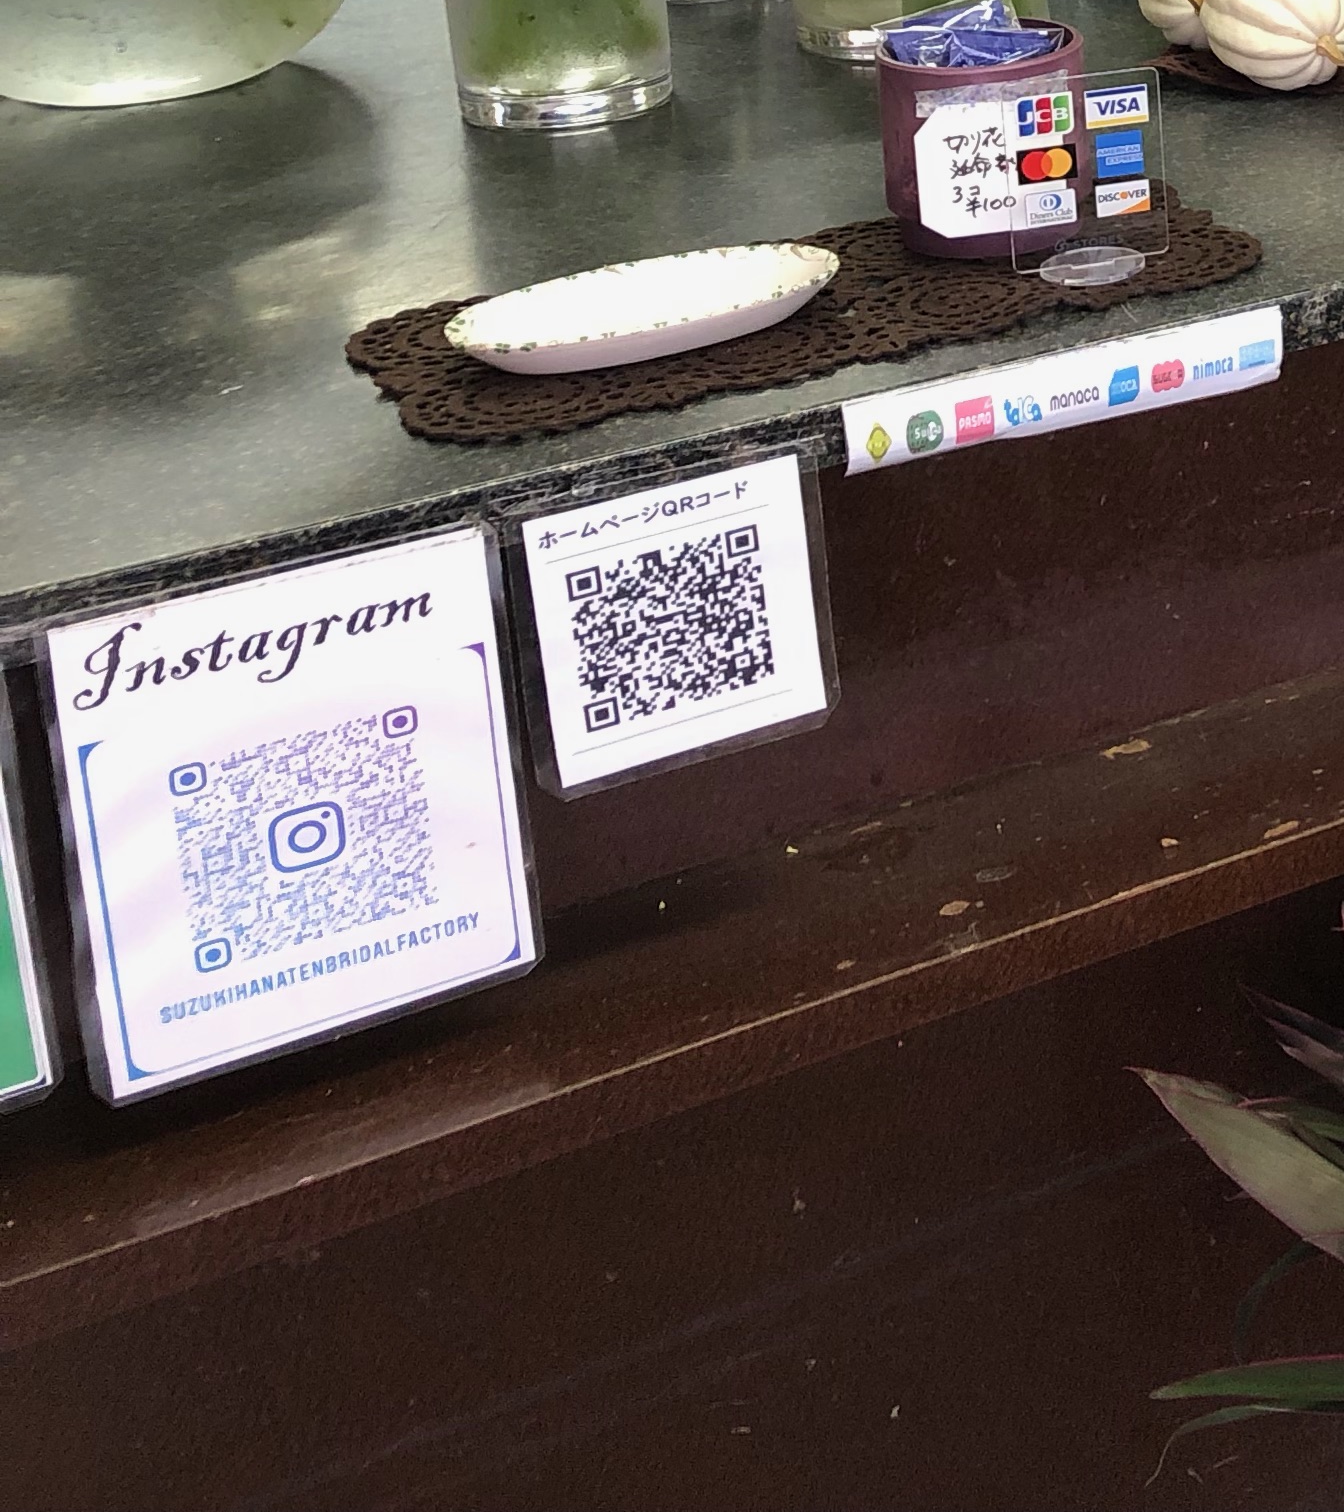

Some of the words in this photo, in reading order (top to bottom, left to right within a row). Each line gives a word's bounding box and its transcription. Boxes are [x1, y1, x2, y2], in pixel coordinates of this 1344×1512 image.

[1093, 96, 1141, 117] VISA
[942, 126, 1006, 156] 切り花
[964, 195, 1017, 219] ¥100
[1097, 188, 1147, 204] DISCOVER
[958, 411, 992, 431] PASMO
[1049, 385, 1100, 412] manaca
[1192, 355, 1234, 381] nimoca
[537, 479, 750, 551] ホームページQRコード
[71, 588, 435, 712] Instagram
[158, 911, 481, 1024] SUZUKIHANATENBRIDALFACTORY
